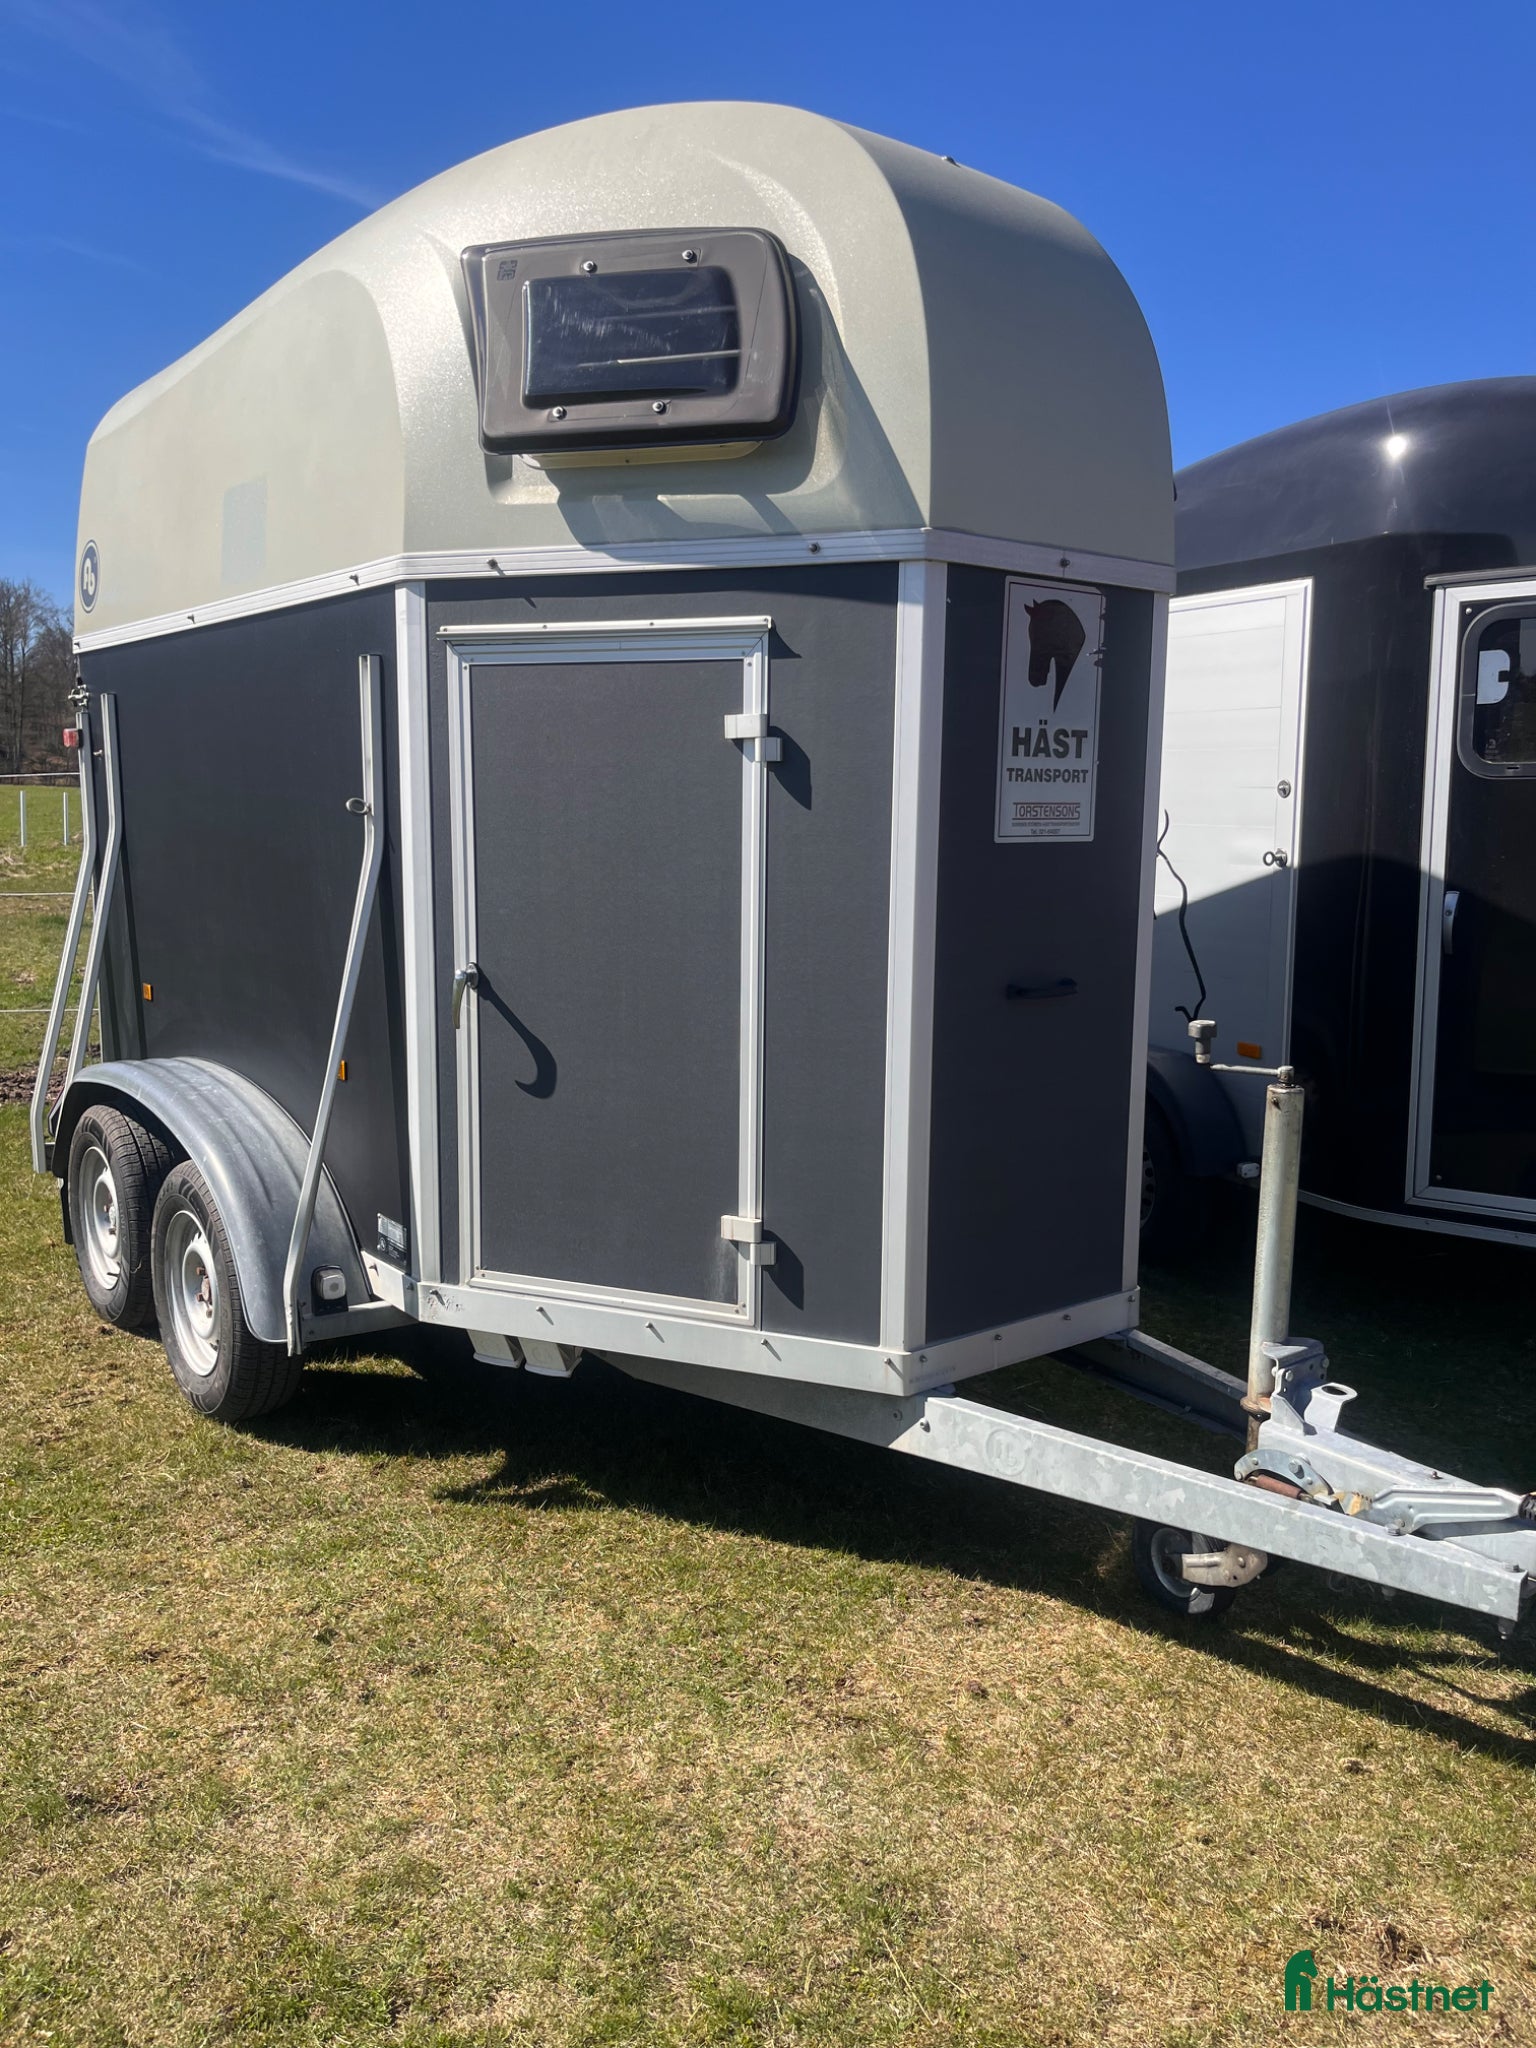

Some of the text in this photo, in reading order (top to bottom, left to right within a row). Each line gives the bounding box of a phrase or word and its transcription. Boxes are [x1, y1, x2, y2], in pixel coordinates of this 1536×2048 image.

[1012, 719, 1088, 758] HÄST
[1006, 767, 1089, 783] TRANSPORT
[1013, 802, 1081, 820] TORSTENSONS
